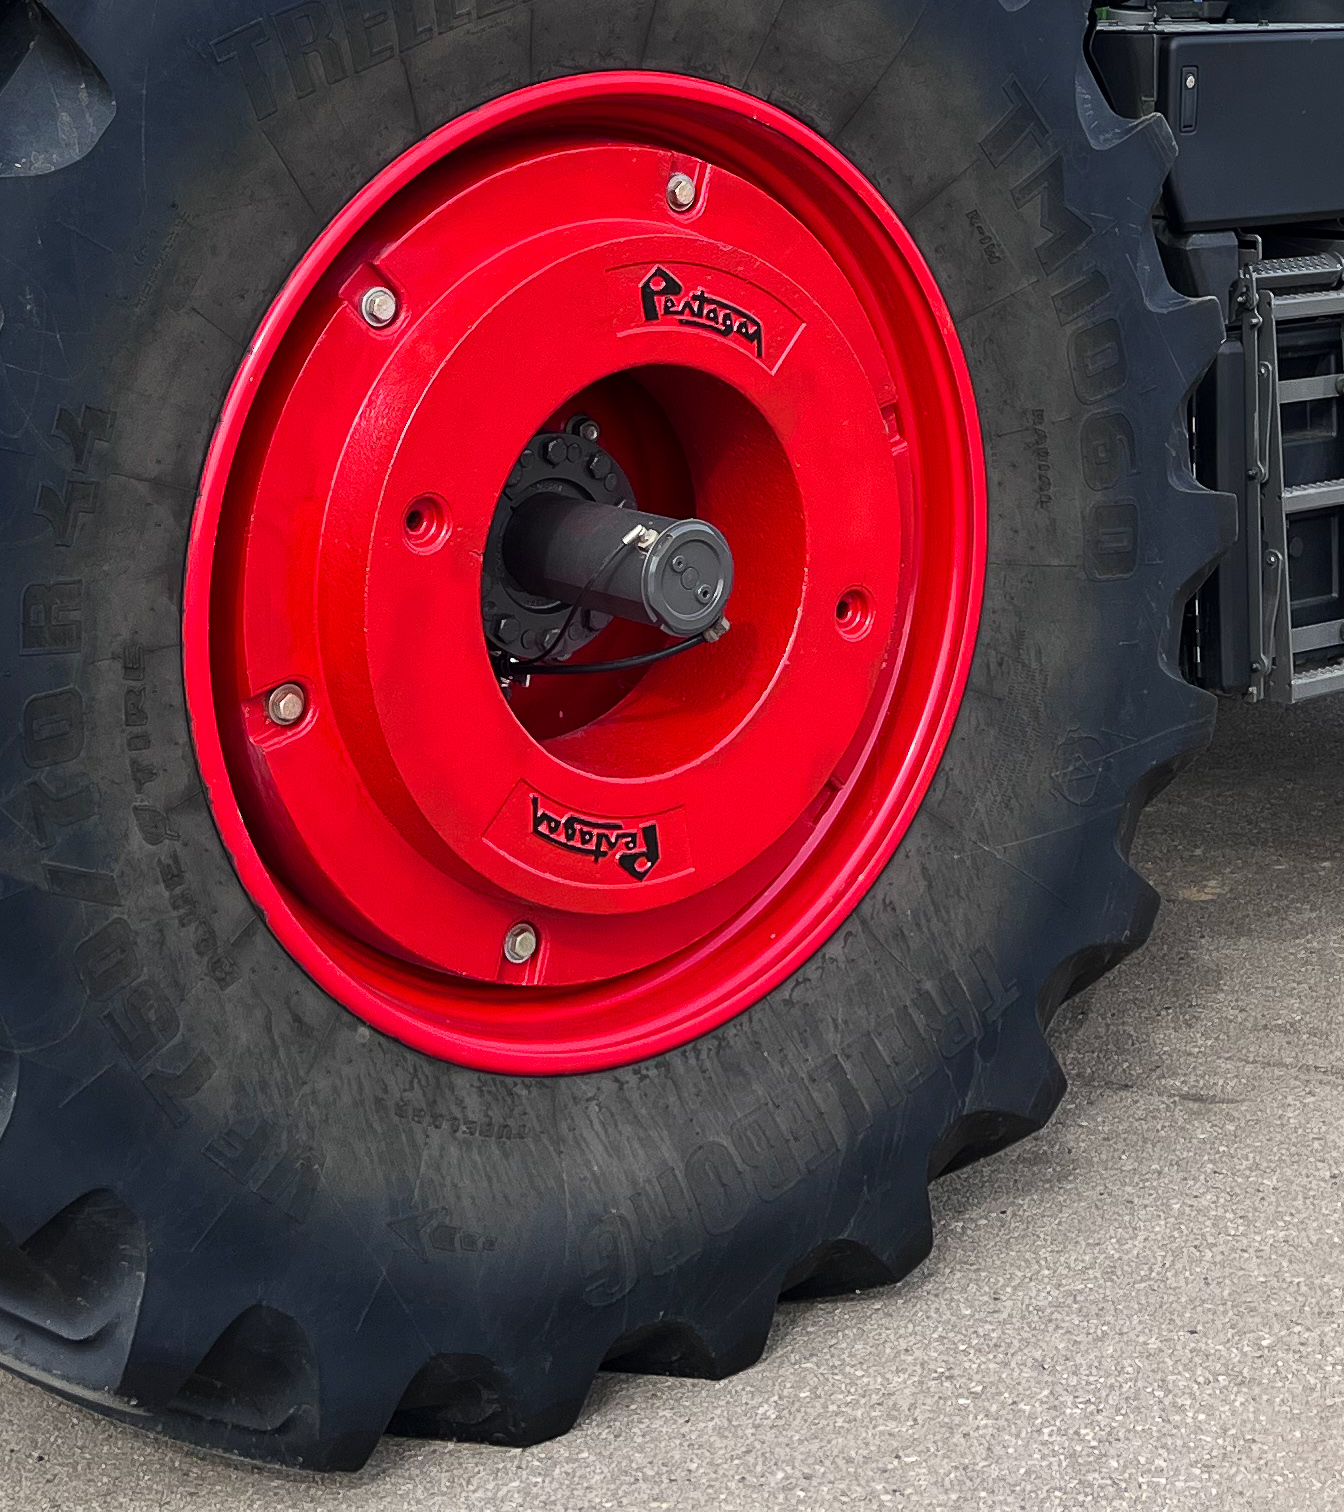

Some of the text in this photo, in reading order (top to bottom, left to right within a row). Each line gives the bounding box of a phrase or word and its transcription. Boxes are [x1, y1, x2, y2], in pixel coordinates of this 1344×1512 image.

[638, 264, 763, 358] Pentagon
[119, 645, 157, 789] TIRE
[577, 943, 1029, 1308] TRELLEBORG
